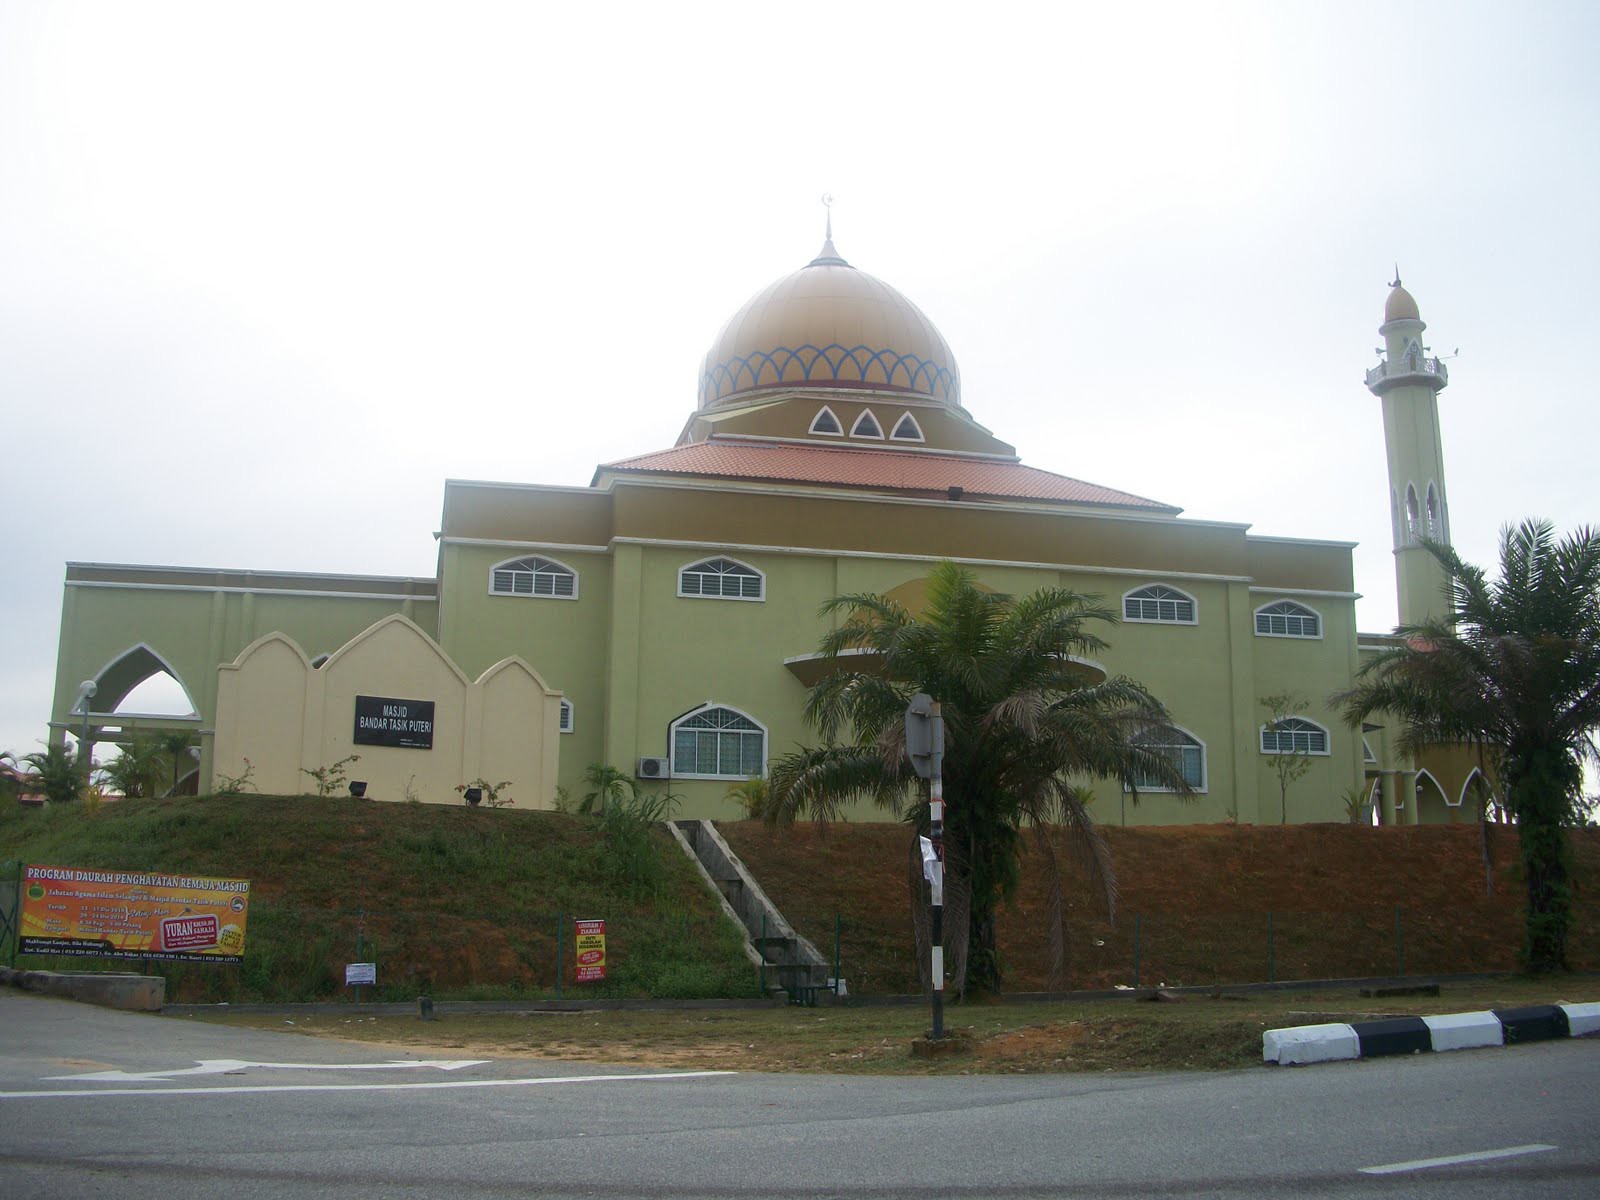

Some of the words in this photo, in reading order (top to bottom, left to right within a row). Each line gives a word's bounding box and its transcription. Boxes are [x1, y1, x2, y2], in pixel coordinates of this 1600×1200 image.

[383, 705, 408, 718] MASJID
[360, 716, 388, 729] BANDAR
[390, 718, 408, 731] TASIK
[409, 720, 432, 733] PUTERI
[28, 867, 73, 881] PROGRAM
[76, 871, 113, 883] DAURAH
[116, 874, 179, 887] PENGHAYATAN
[180, 878, 214, 890] REMAJA
[216, 880, 249, 893] MASJID
[75, 891, 96, 899] Agama
[115, 893, 142, 902] Selangor
[150, 896, 169, 904] Masjid
[165, 921, 193, 937] YURAN
[193, 927, 215, 935] SAHAJA
